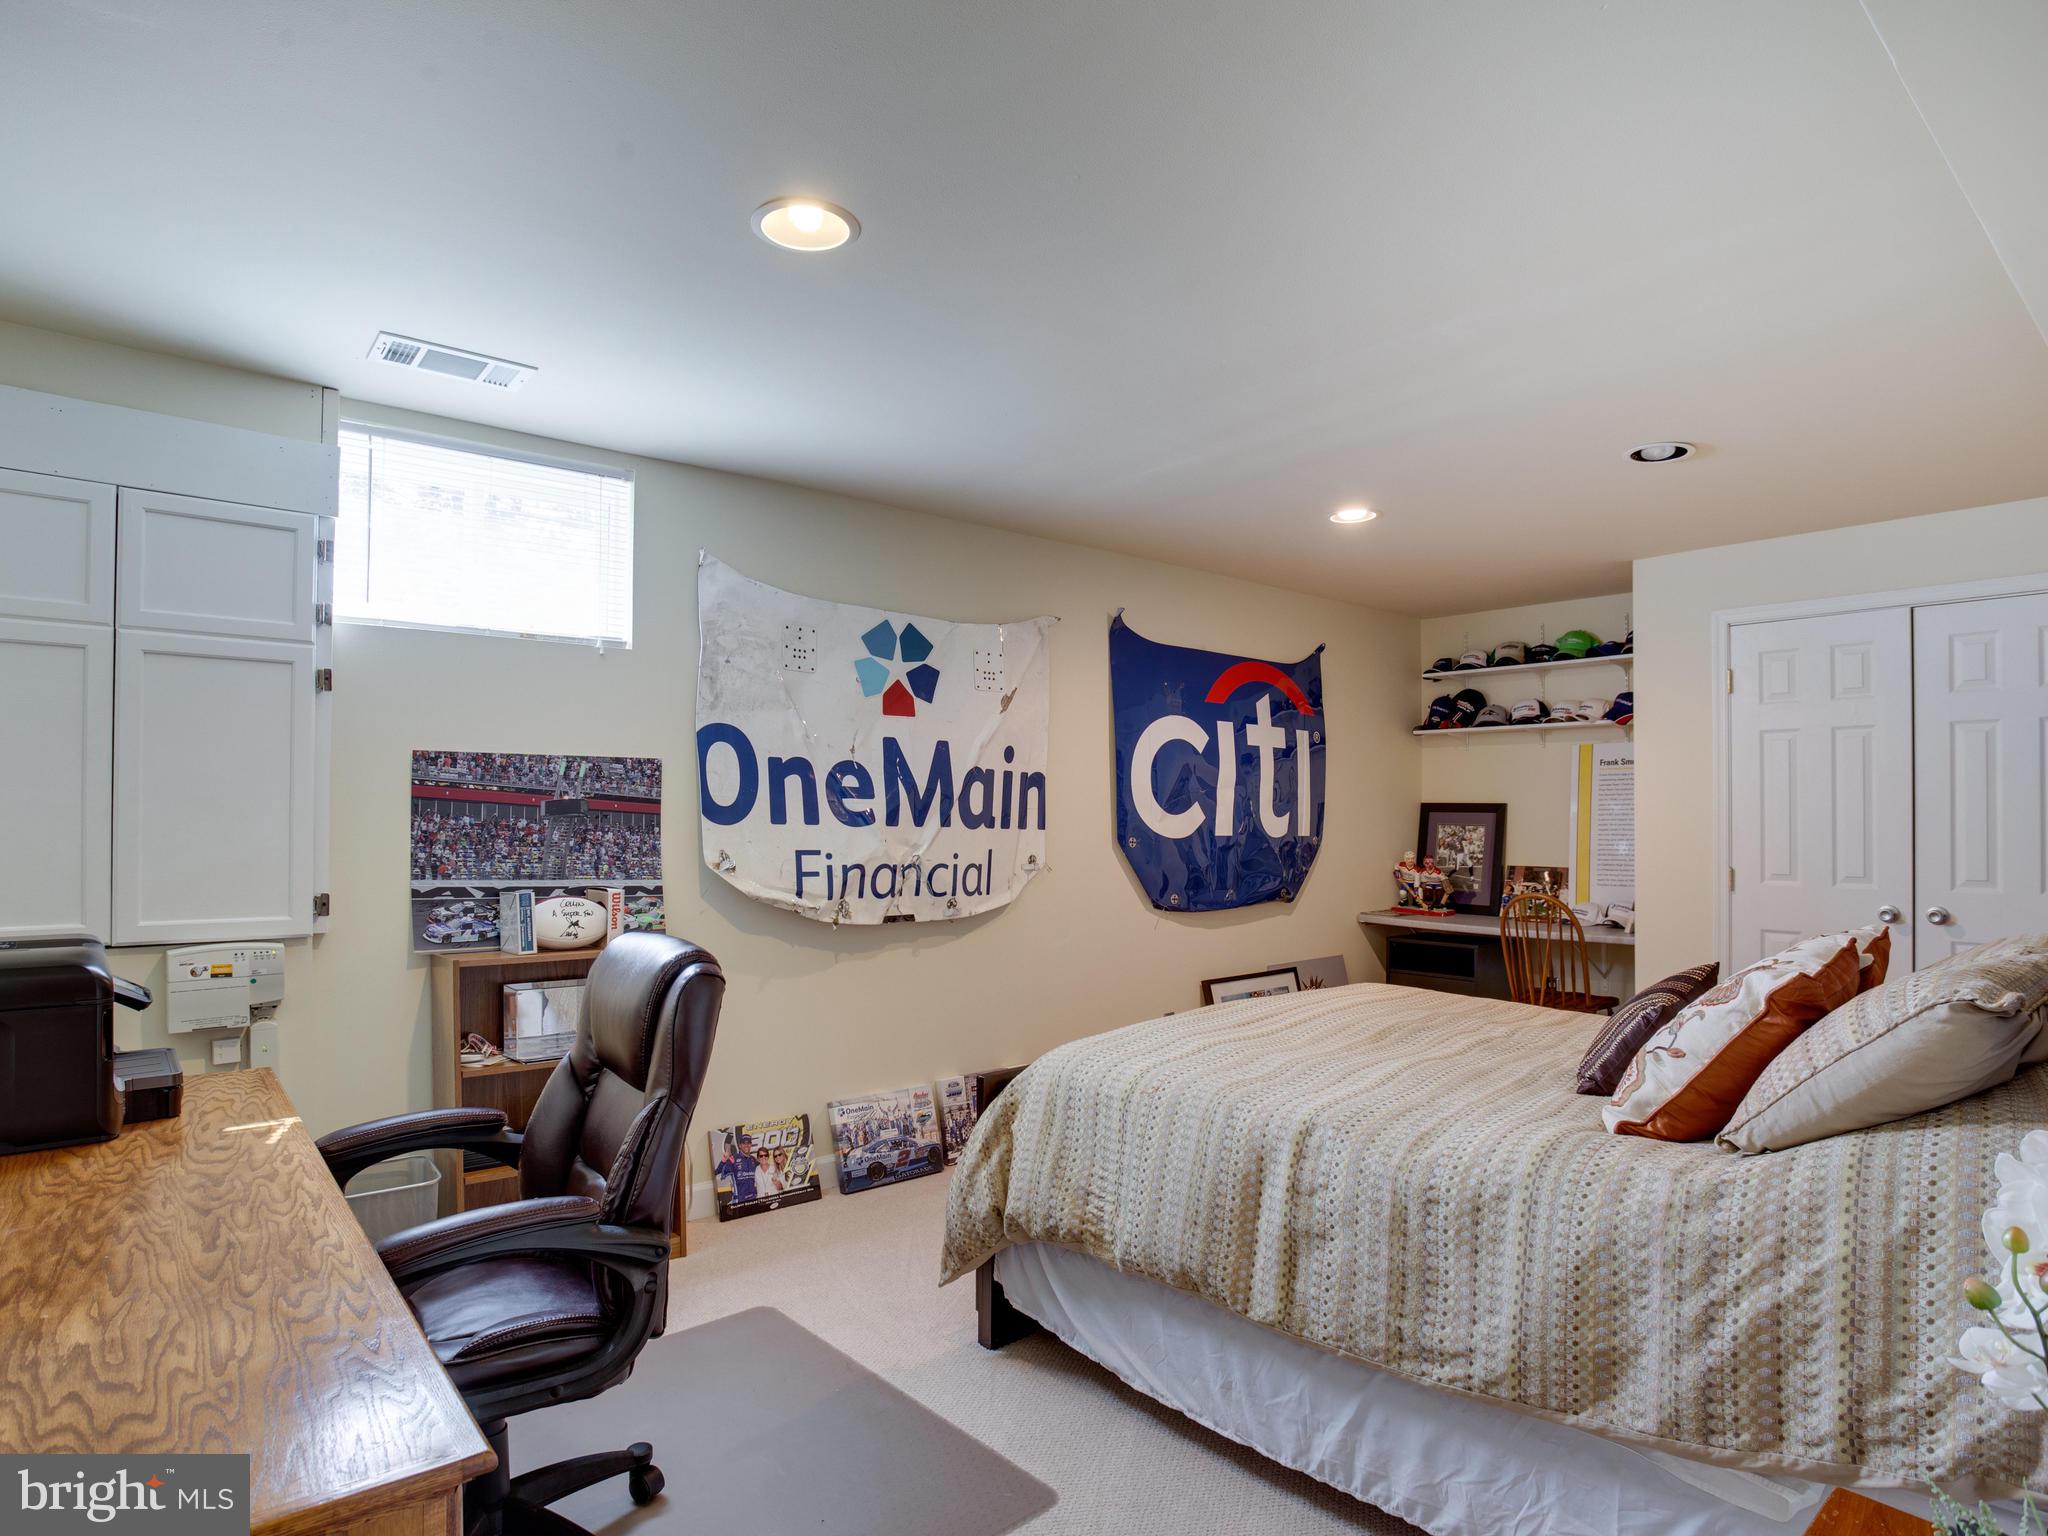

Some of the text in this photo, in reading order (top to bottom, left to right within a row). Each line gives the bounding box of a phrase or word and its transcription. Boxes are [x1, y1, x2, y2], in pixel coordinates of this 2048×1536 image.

[696, 723, 1046, 830] OneMain
[1131, 693, 1311, 839] citi
[1600, 757, 1620, 766] Frank
[795, 849, 993, 900] Financial
[611, 892, 621, 930] Wilson
[846, 1104, 874, 1115] OneMain
[865, 1153, 892, 1163] OneMain
